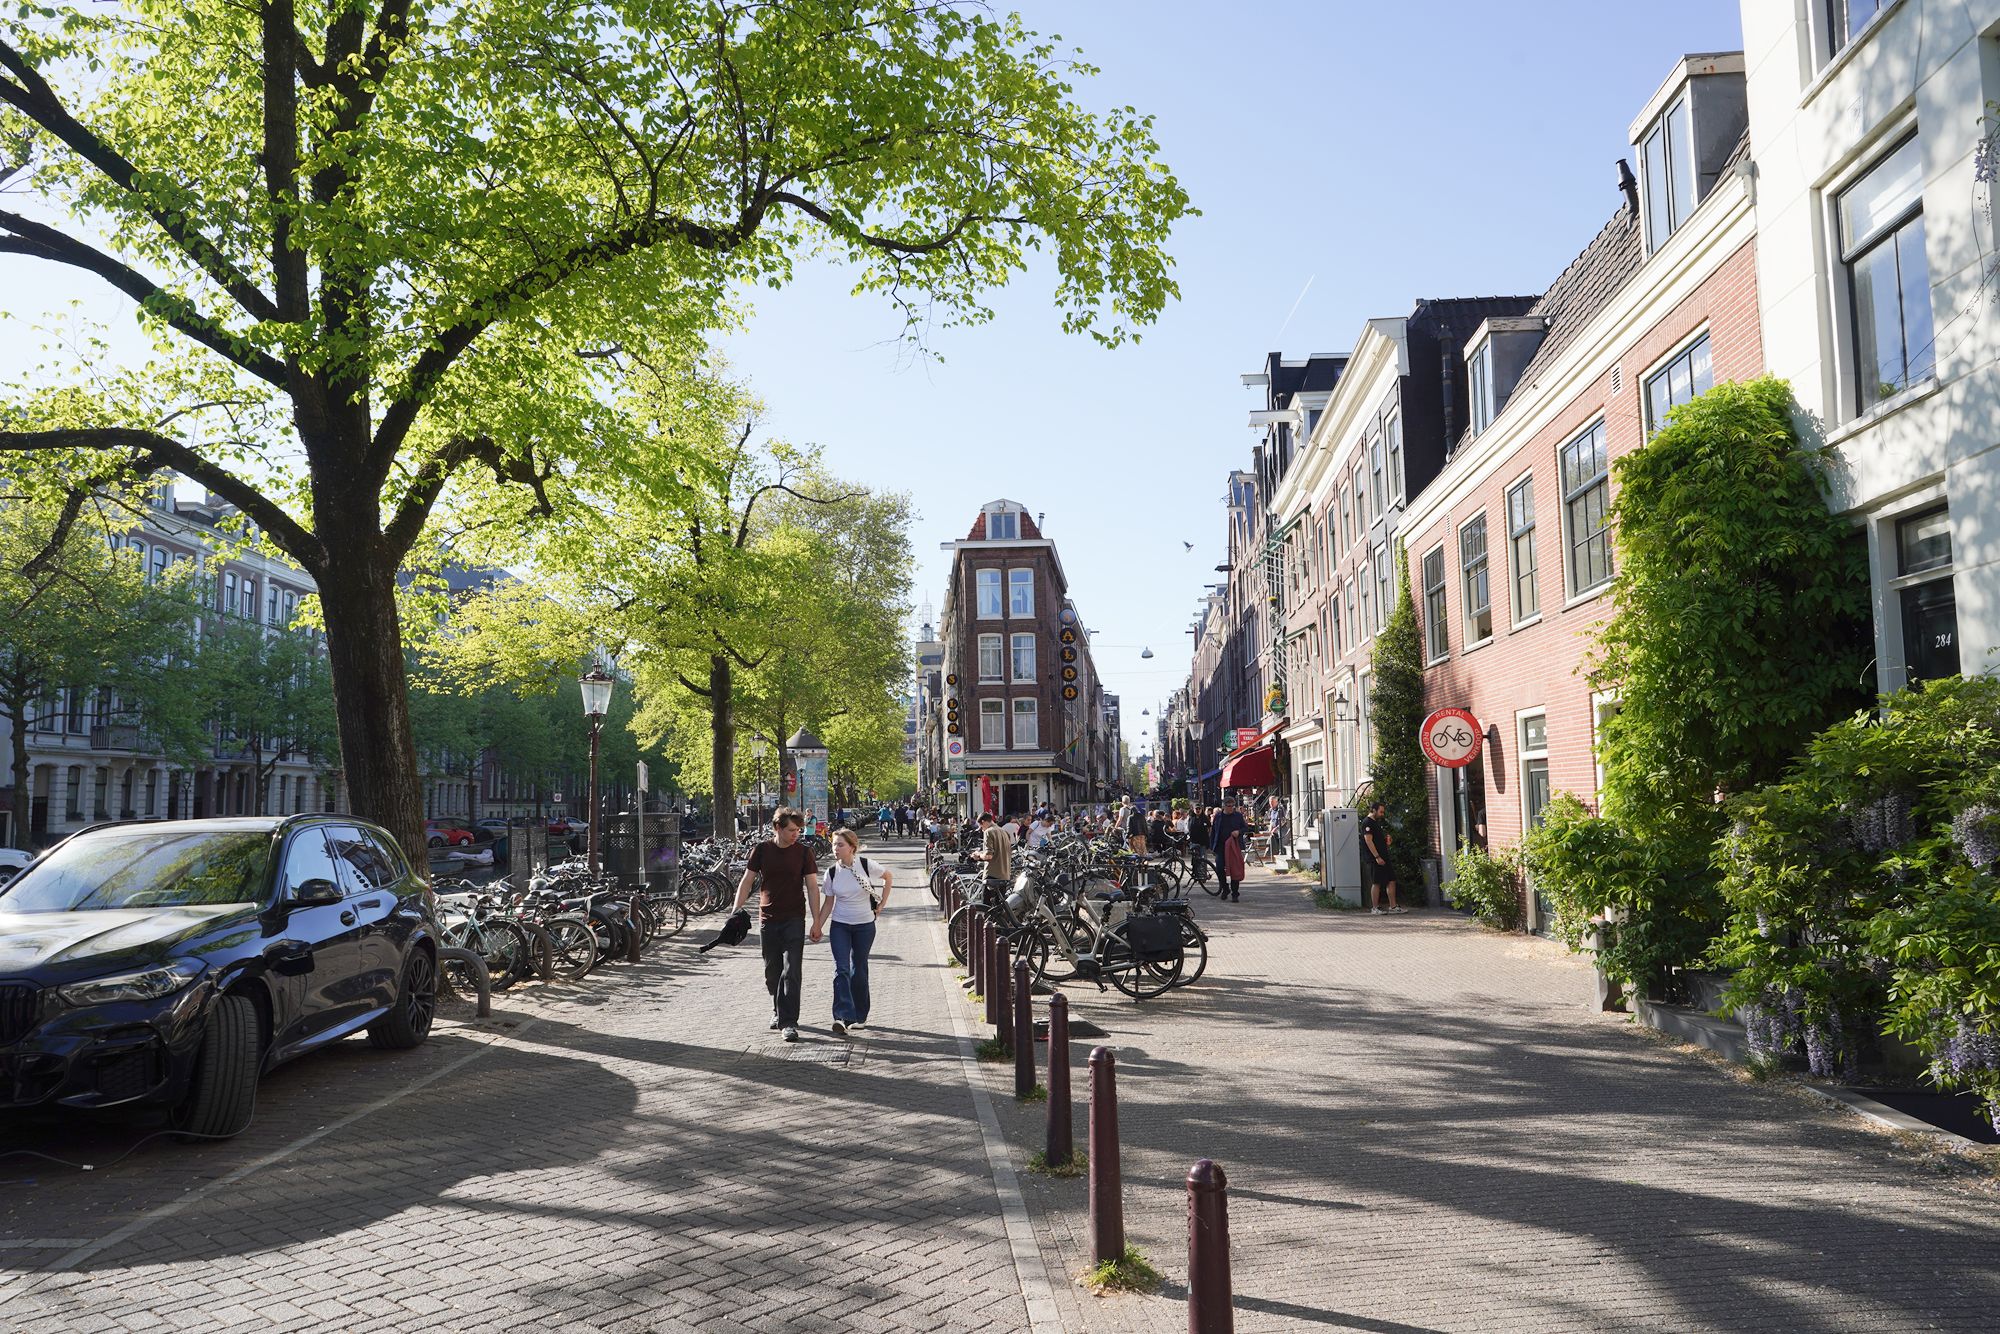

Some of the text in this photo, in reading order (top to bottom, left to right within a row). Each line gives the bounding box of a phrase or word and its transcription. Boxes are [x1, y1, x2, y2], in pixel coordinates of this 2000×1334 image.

[1935, 633, 1951, 648] 284
[1434, 708, 1466, 720] RENTAL
[1423, 731, 1450, 767] REPARATIE
[1463, 728, 1482, 763] VERKOOP
